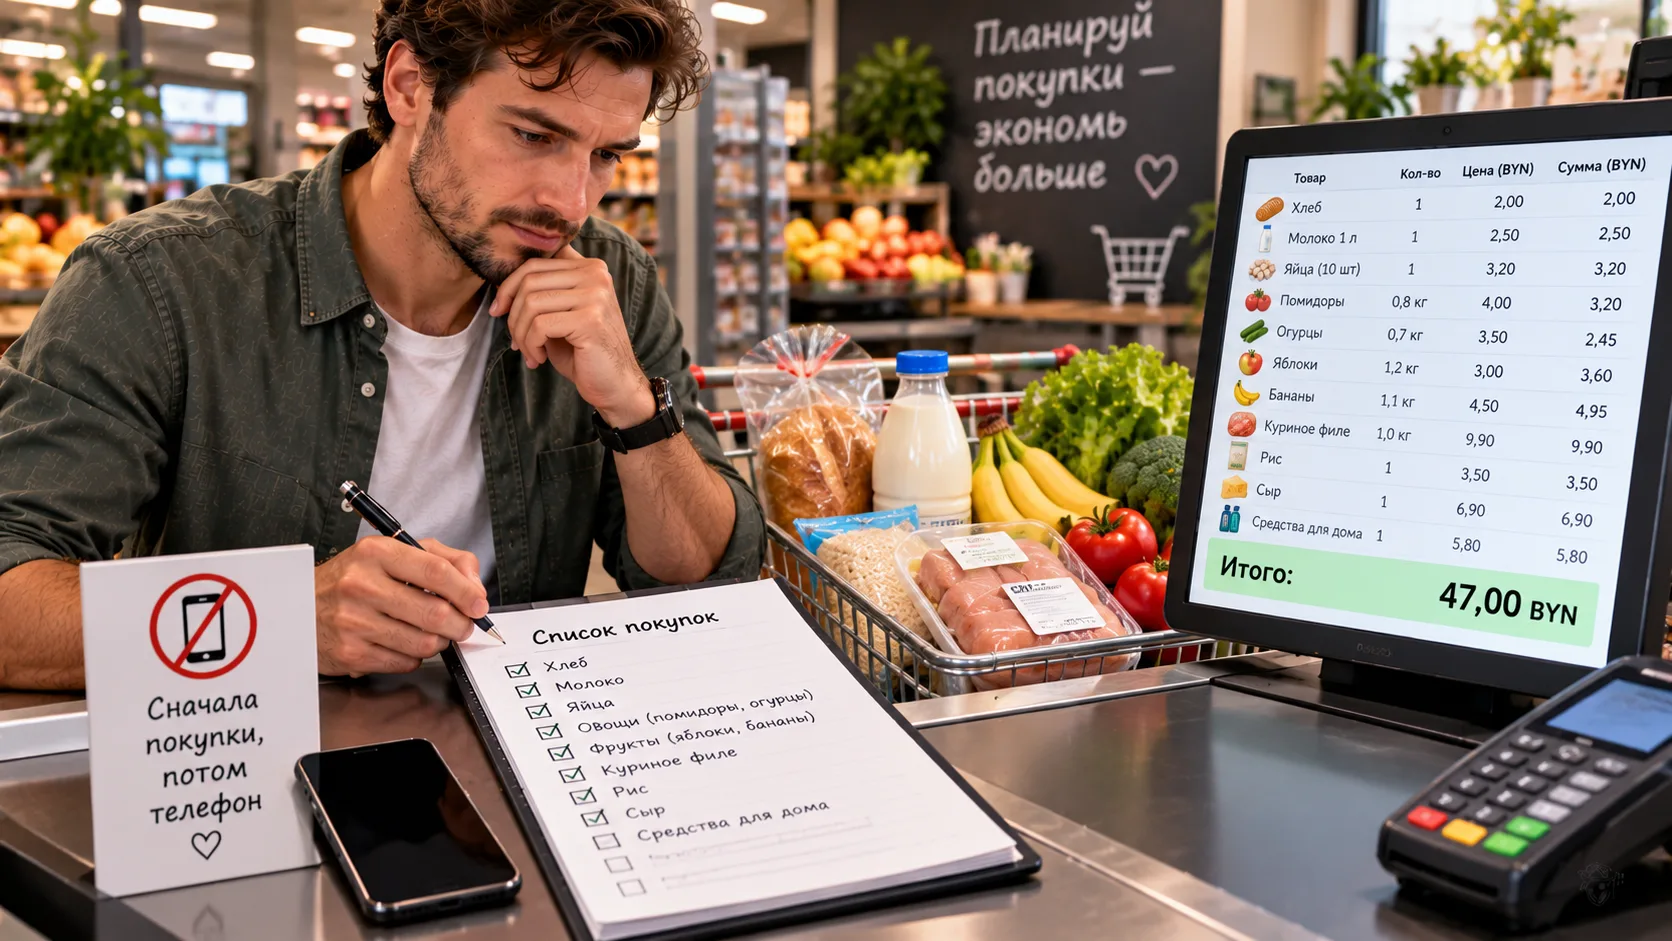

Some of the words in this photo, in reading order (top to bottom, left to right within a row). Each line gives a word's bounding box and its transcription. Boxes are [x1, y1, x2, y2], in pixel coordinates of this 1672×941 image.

[974, 0, 1153, 58] Планируй
[974, 63, 1124, 109] покупки
[974, 110, 1128, 148] экономь
[974, 152, 1107, 193] больше
[1462, 165, 1494, 178] Цена
[1497, 162, 1534, 177] (BYN)
[1557, 161, 1603, 175] Сумма
[1606, 156, 1646, 173] (BYN)
[1293, 172, 1327, 185] Товар
[1400, 168, 1442, 179] Кол-во
[1291, 200, 1322, 213] Хлеб
[1415, 197, 1422, 210] 1
[1494, 194, 1524, 209] 2,00
[1603, 191, 1636, 207] 2,00
[1287, 232, 1336, 244] Молоко
[1339, 231, 1346, 243] 1
[1348, 234, 1358, 244] л
[1411, 230, 1418, 242] 1
[1489, 228, 1520, 243] 2,50
[1598, 226, 1631, 241] 2,50
[1283, 262, 1314, 276] Яйца
[1317, 262, 1337, 277] (10
[1339, 262, 1361, 277] шт)
[1408, 262, 1415, 275] 1
[1486, 262, 1516, 276] 3,20
[1594, 261, 1627, 277] 3,20
[1280, 294, 1345, 309] Помидоры
[1391, 295, 1411, 309] 0,8
[1414, 298, 1428, 308] кг
[1481, 296, 1512, 311] 4,00
[1589, 296, 1622, 312] 3,20
[1276, 324, 1323, 341] Огурцы
[1387, 327, 1407, 342] 0,7
[1409, 331, 1424, 341] кг
[1478, 329, 1508, 344] 3,50
[1585, 332, 1617, 348] 2,45
[1272, 356, 1318, 370] Яблоки
[1384, 360, 1403, 375] 1,2
[1405, 364, 1420, 375] кг
[1474, 363, 1504, 378] 3,00
[1580, 367, 1613, 384] 3,60
[1268, 387, 1315, 402] Бананы
[1381, 393, 1398, 408] 1,1
[1401, 397, 1416, 408] кг
[1469, 398, 1499, 413] 4,50
[1575, 404, 1608, 419] 4,95
[1264, 419, 1316, 435] Куриное
[1318, 423, 1351, 438] филе
[1377, 427, 1395, 441] 1,0
[1398, 431, 1412, 442] кг
[1465, 432, 1495, 447] 9,90
[1571, 439, 1603, 454] 9,90
[1260, 451, 1283, 464] Рис
[1385, 461, 1392, 474] 1
[1461, 467, 1491, 482] 3,50
[1566, 475, 1598, 491] 3,50
[1256, 483, 1282, 500] Сыр
[1381, 495, 1387, 508] 1
[1456, 502, 1486, 517] 6,90
[1561, 511, 1593, 527] 6,90
[1252, 515, 1305, 532] Средства
[1306, 524, 1330, 535] для
[1331, 527, 1363, 539] дома
[1376, 529, 1383, 542] 1
[1452, 536, 1481, 552] 5,80
[1556, 547, 1588, 564] 5,80
[1221, 555, 1292, 584] Итого:
[1439, 582, 1521, 617] 47,00
[1530, 601, 1577, 625] BYN
[533, 626, 617, 644] Список
[625, 613, 719, 633] покупок
[544, 657, 587, 672] Хлеб
[556, 677, 623, 692] Молоко
[148, 694, 258, 720] Сначала
[567, 700, 614, 712] Яйца
[578, 719, 639, 732] Овощи
[647, 704, 744, 725] (помидоры,
[750, 689, 813, 708] огурцы)
[590, 738, 660, 755] Фрукты
[668, 727, 740, 744] (яблоки,
[746, 711, 814, 730] бананы)
[147, 728, 263, 756] покупки,
[601, 758, 681, 777] Куриное
[690, 749, 737, 765] филе
[164, 762, 247, 787] потом
[613, 786, 648, 797] Рис
[150, 792, 261, 824] телефон
[626, 807, 665, 818] Сыр
[638, 820, 730, 843] Средства
[740, 812, 772, 826] для
[782, 802, 829, 819] дома
